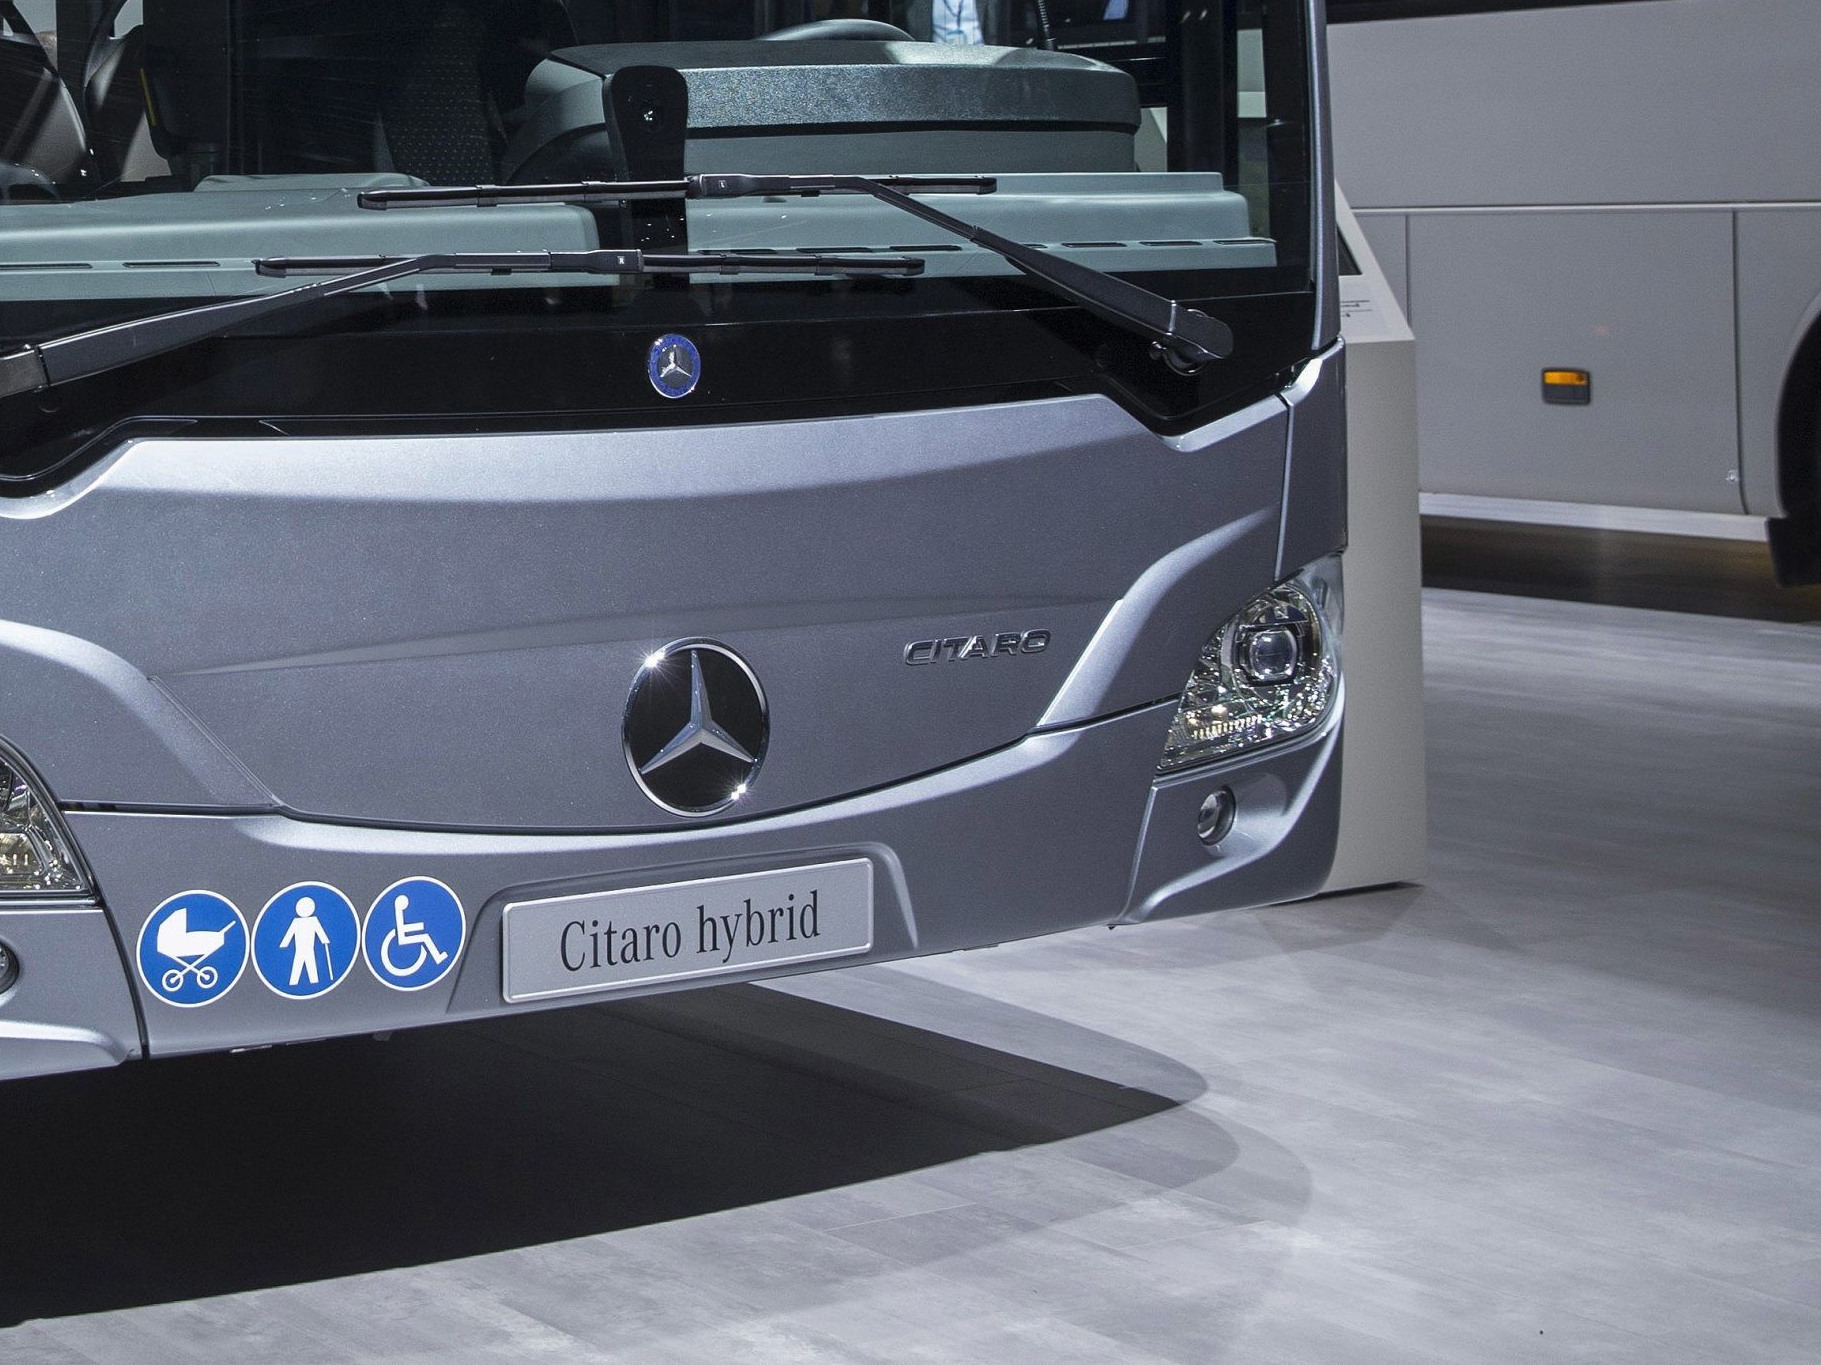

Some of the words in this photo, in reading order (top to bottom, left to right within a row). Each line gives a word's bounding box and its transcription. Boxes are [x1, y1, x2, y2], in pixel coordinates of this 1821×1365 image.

[903, 628, 1052, 667] CITARO
[560, 919, 682, 972] Citaro
[696, 889, 820, 964] hybrid
